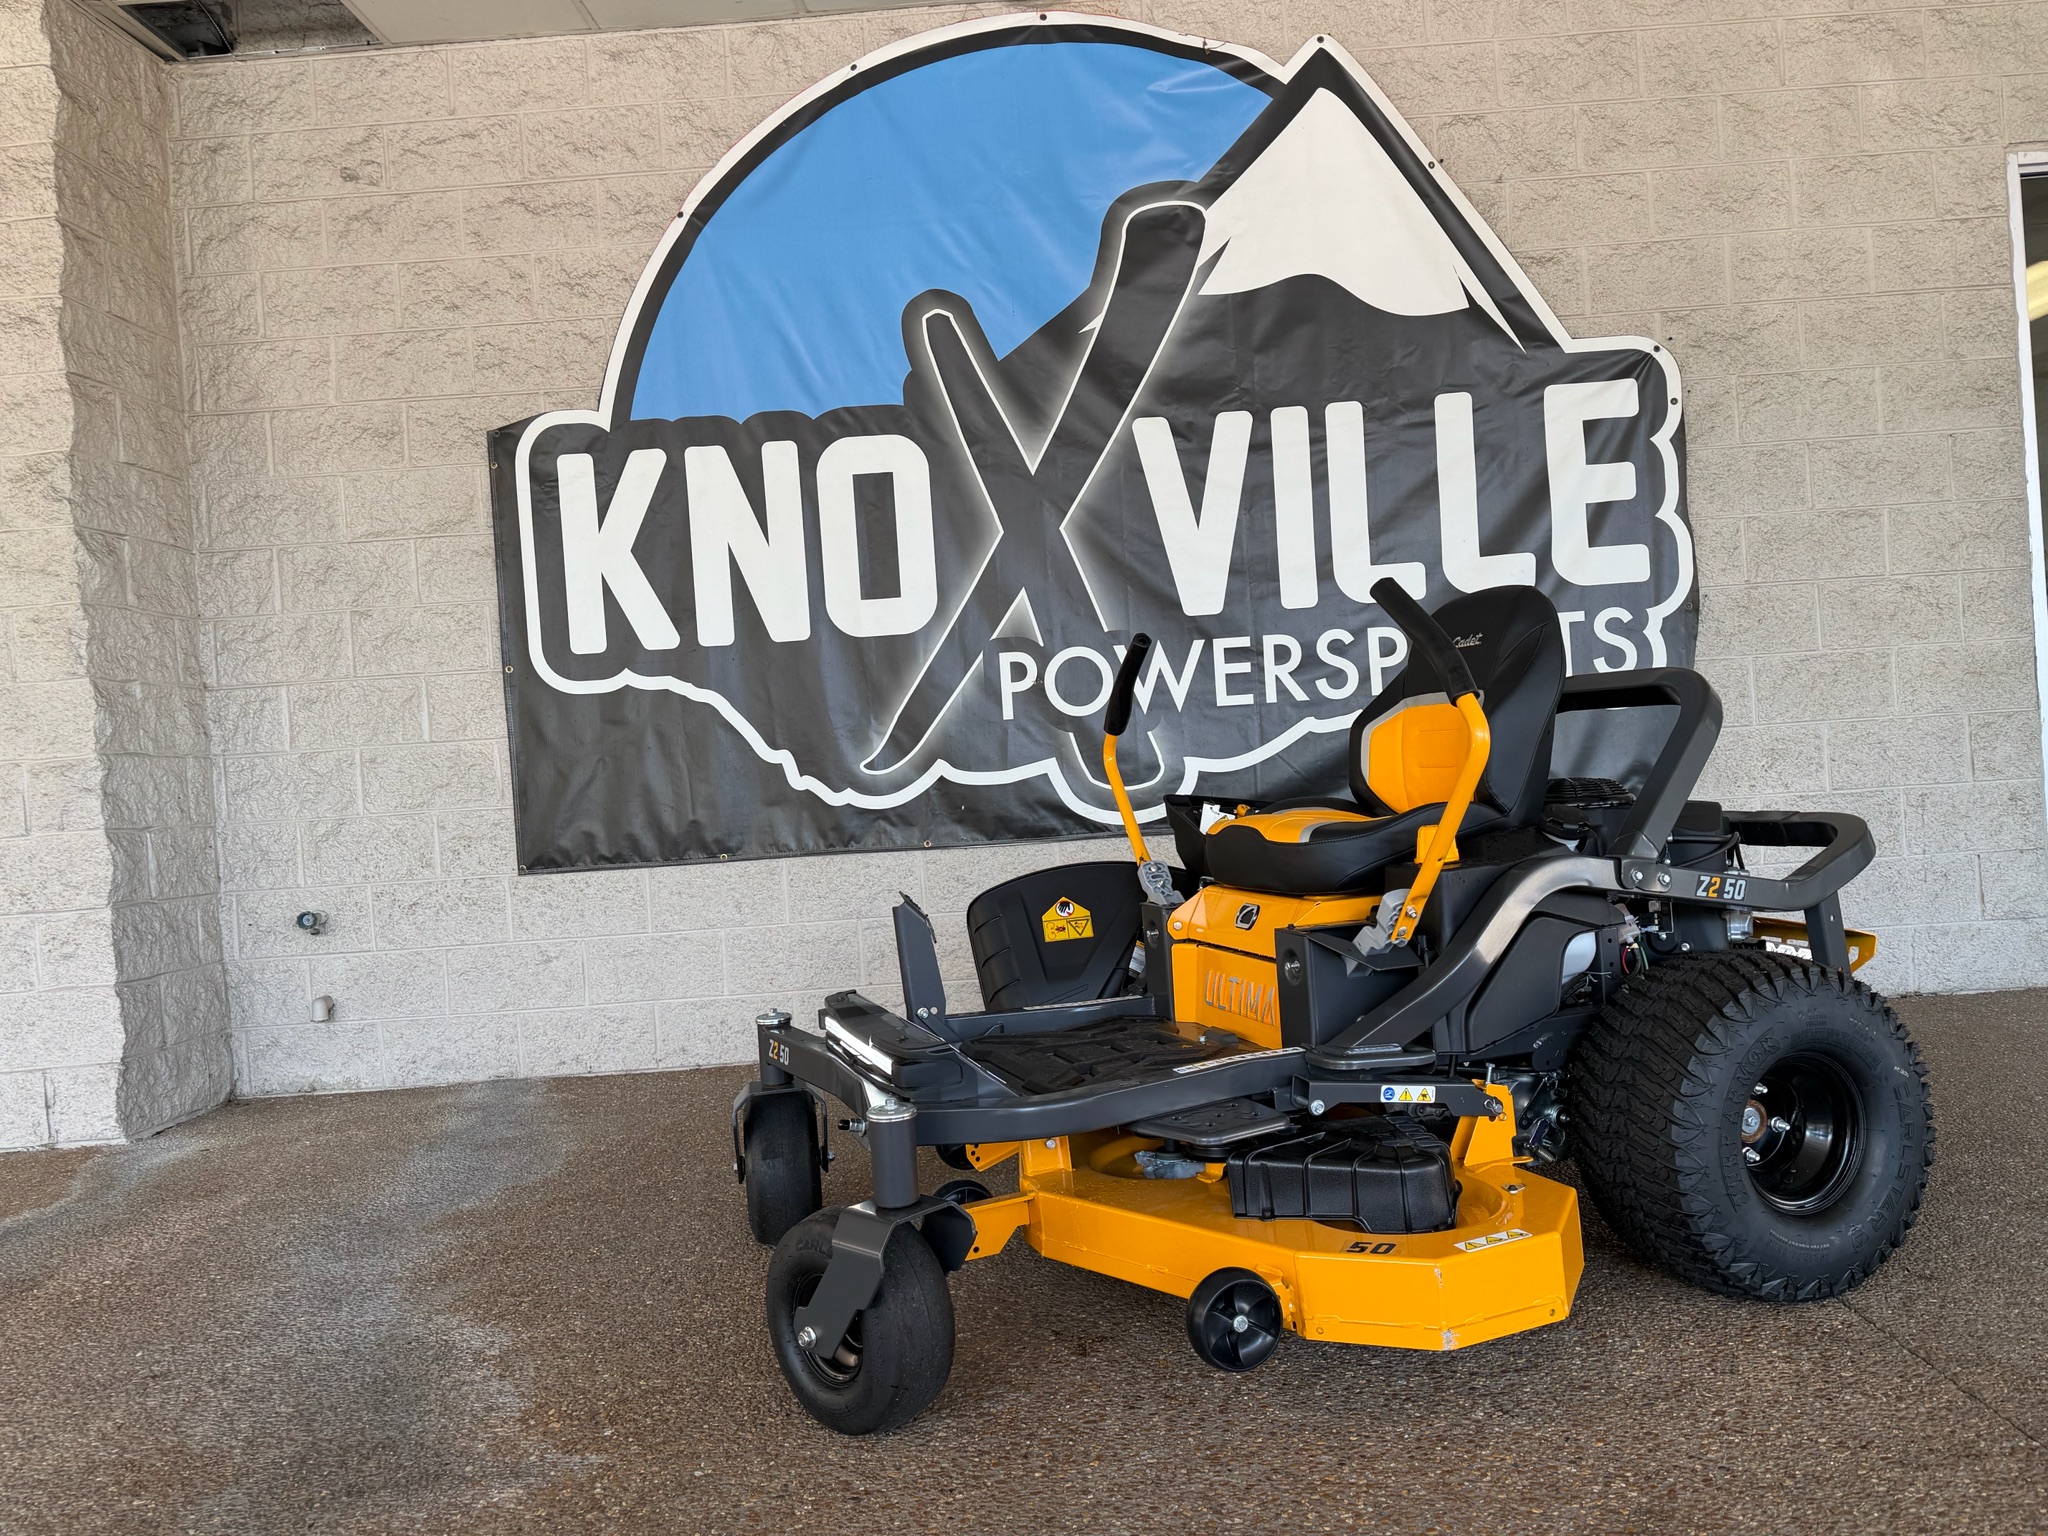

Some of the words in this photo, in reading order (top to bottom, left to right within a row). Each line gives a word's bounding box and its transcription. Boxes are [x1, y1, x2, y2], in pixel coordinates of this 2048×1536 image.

[556, 199, 1651, 789] KNOXVILLE
[1000, 606, 1638, 720] POWERSPTS
[1723, 878, 1746, 900] 50
[1205, 970, 1277, 1026] ULTIMA
[1346, 1241, 1397, 1255] 50
